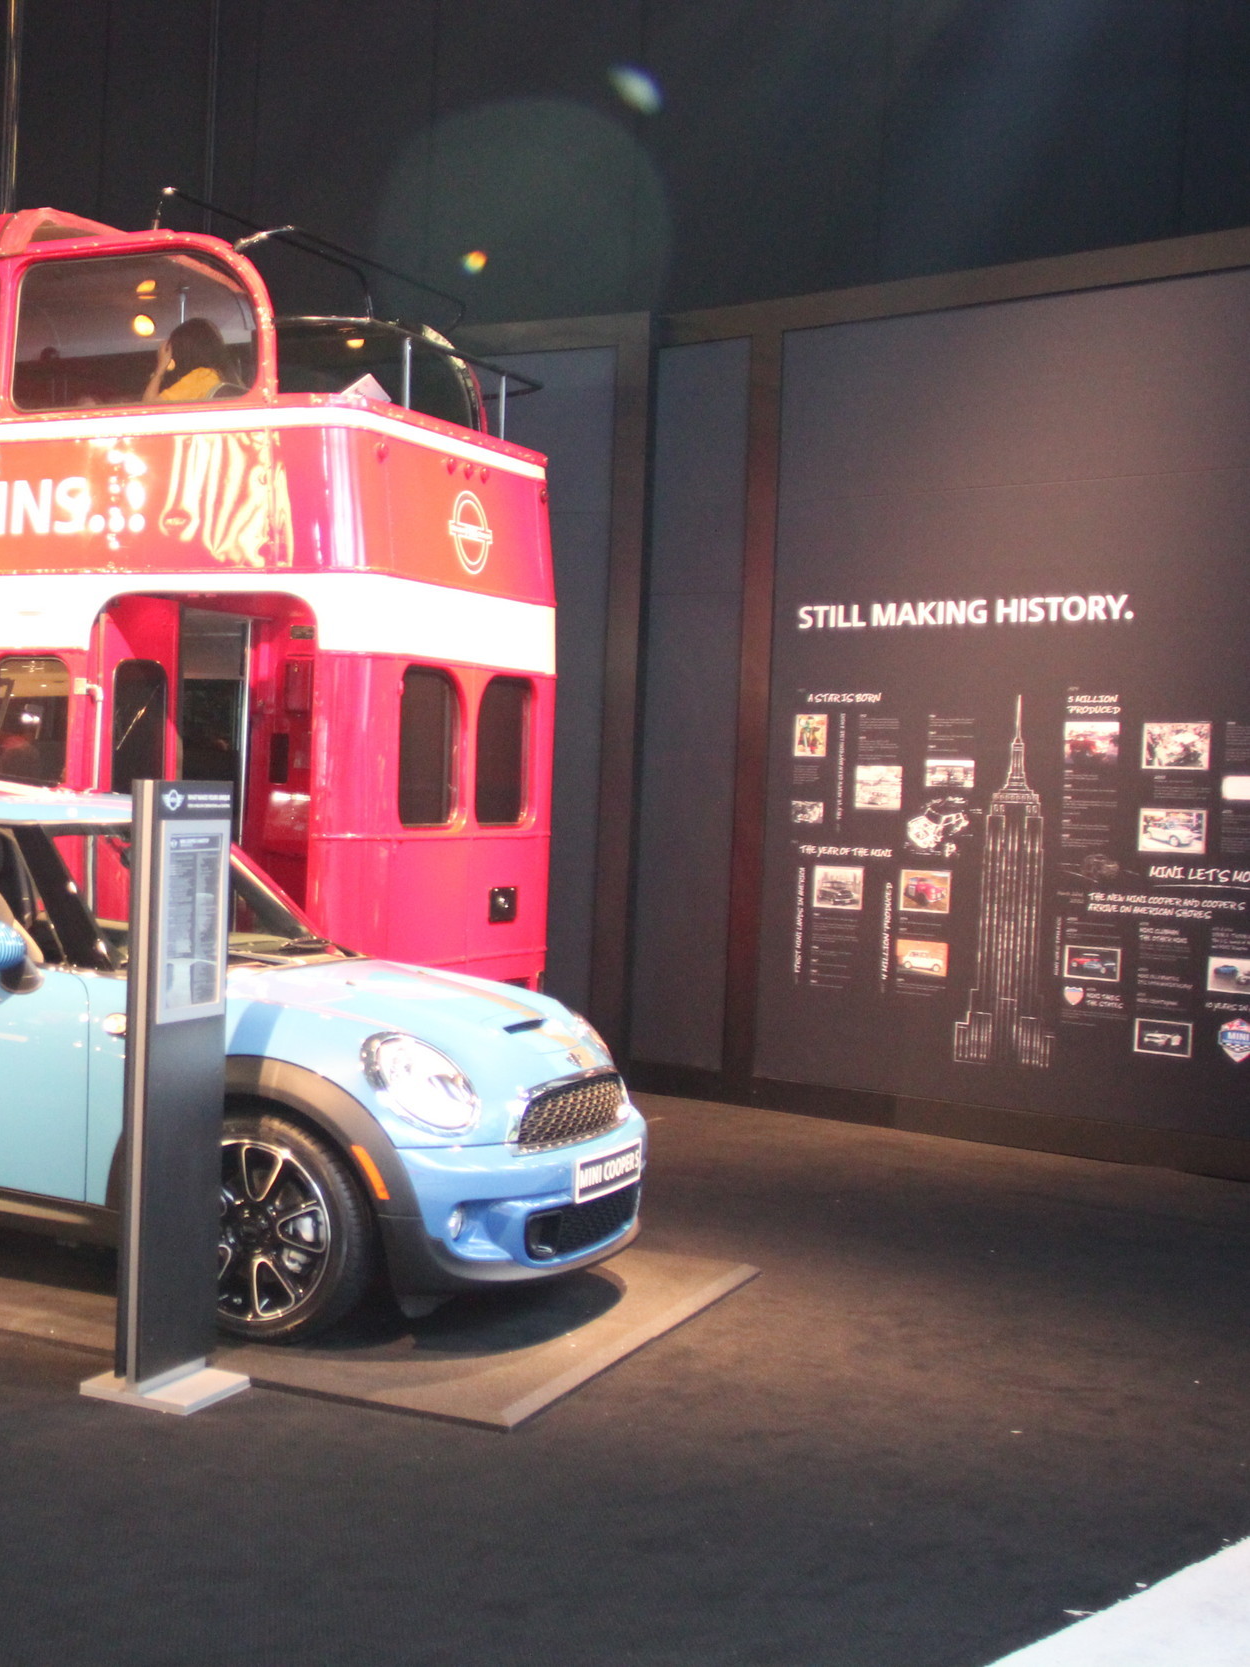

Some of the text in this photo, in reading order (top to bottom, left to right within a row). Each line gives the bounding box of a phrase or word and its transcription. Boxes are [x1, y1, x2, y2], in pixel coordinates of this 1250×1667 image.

[799, 594, 1135, 629] STILL MAKING HISTORY.
[814, 693, 841, 703] STAR
[841, 693, 854, 703] IS
[855, 692, 882, 703] BORN
[1075, 694, 1119, 703] MILLION
[1066, 705, 1121, 714] PRODUCED
[800, 845, 893, 858] THE YEAR OF THE MINI
[1149, 865, 1185, 880] MINI
[1188, 868, 1230, 883] LET'S
[883, 882, 893, 932] PRODUCED
[1088, 892, 1105, 901] THE
[1107, 893, 1125, 902] NEW
[1126, 894, 1146, 904] MINI
[1148, 897, 1182, 907] COOPER
[1183, 897, 1200, 908] AND
[1201, 899, 1236, 910] COOPER
[1088, 903, 1212, 919] ARRIVE ON AMERICAN SHORES
[881, 933, 890, 973] MILLION
[580, 1164, 603, 1190] MINI
[603, 1153, 634, 1181] COOPER
